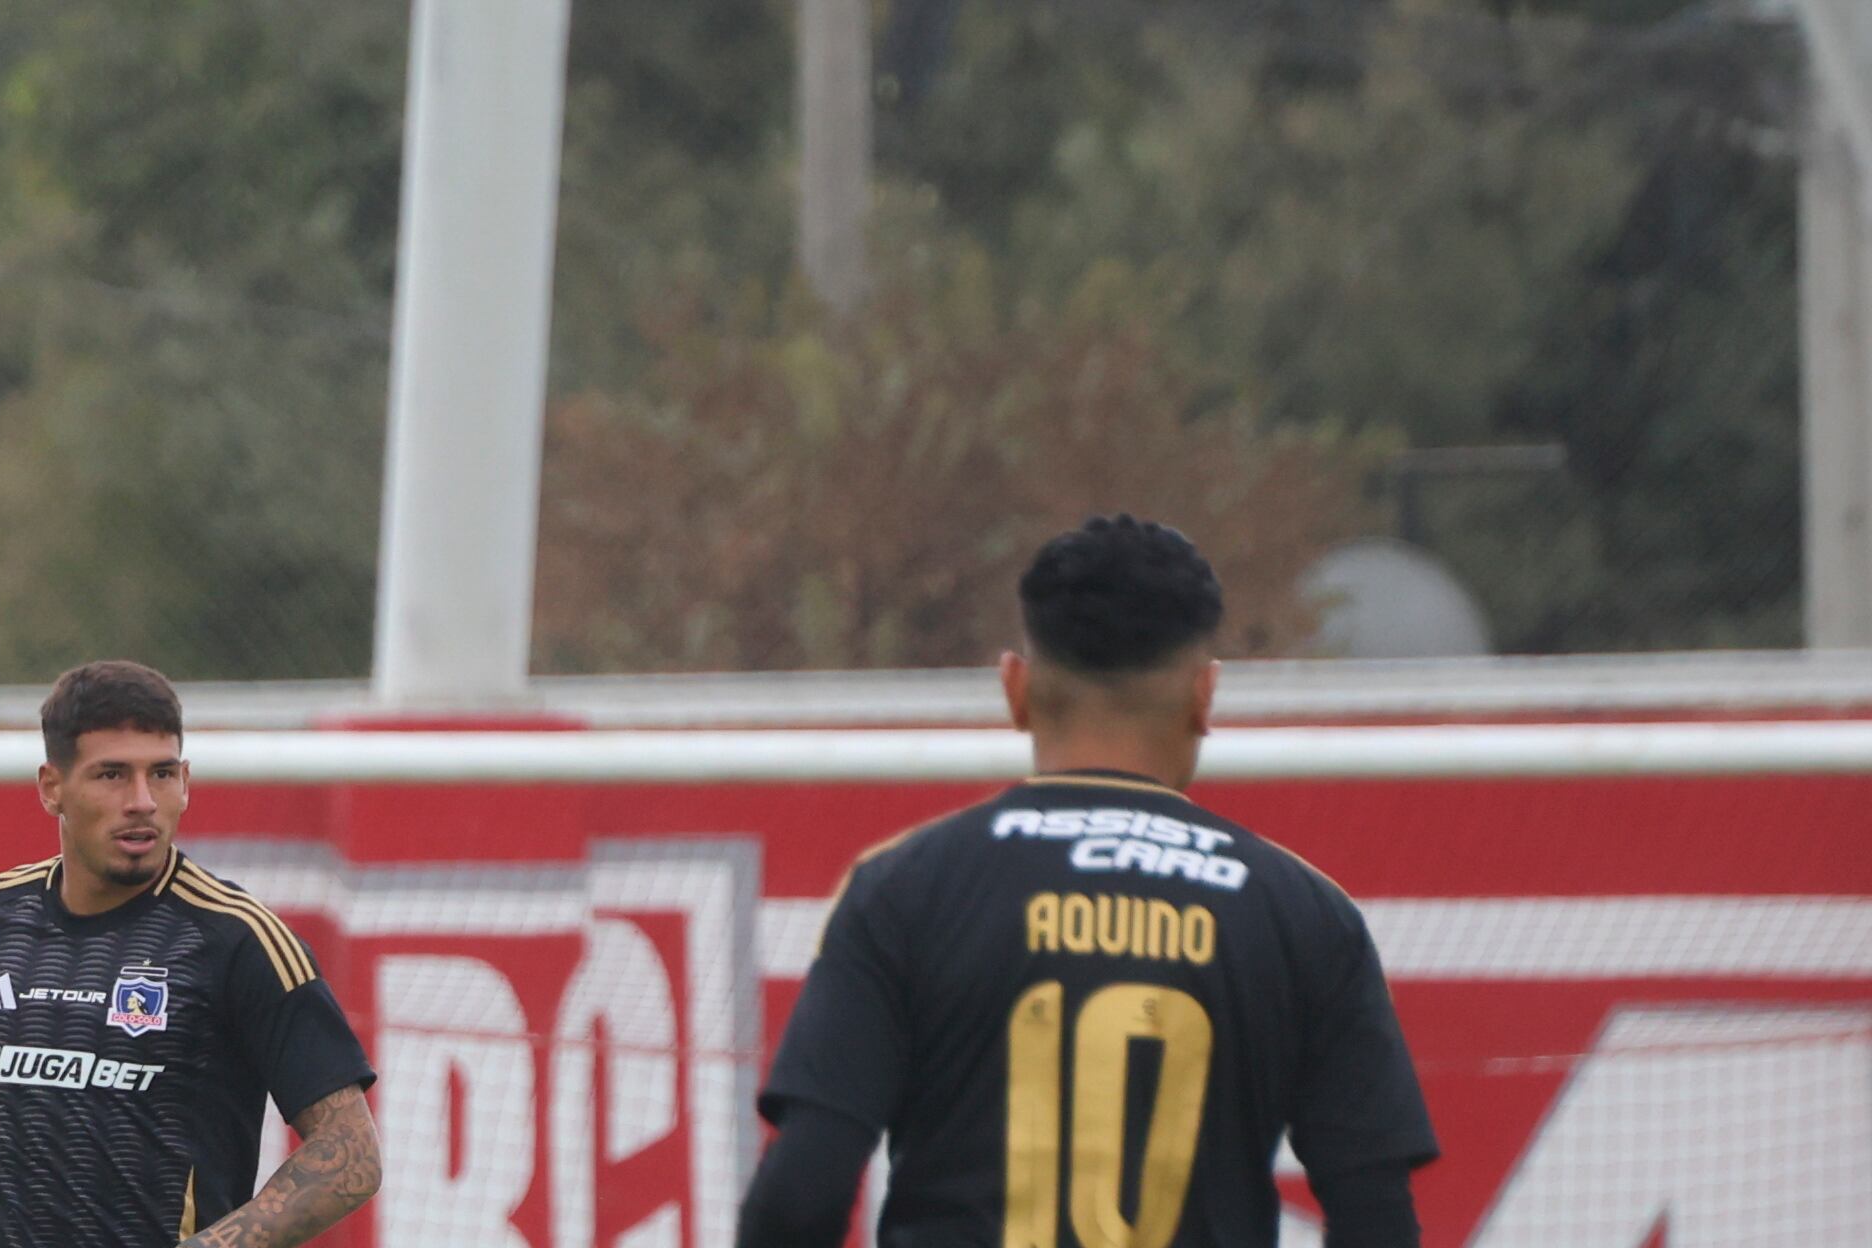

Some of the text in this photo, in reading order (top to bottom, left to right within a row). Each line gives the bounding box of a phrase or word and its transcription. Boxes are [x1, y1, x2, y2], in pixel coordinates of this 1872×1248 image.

[992, 808, 1235, 850] ASSIST
[1071, 838, 1250, 890] CARD
[1026, 891, 1217, 966] AQUINO
[19, 988, 107, 1004] JETOUR
